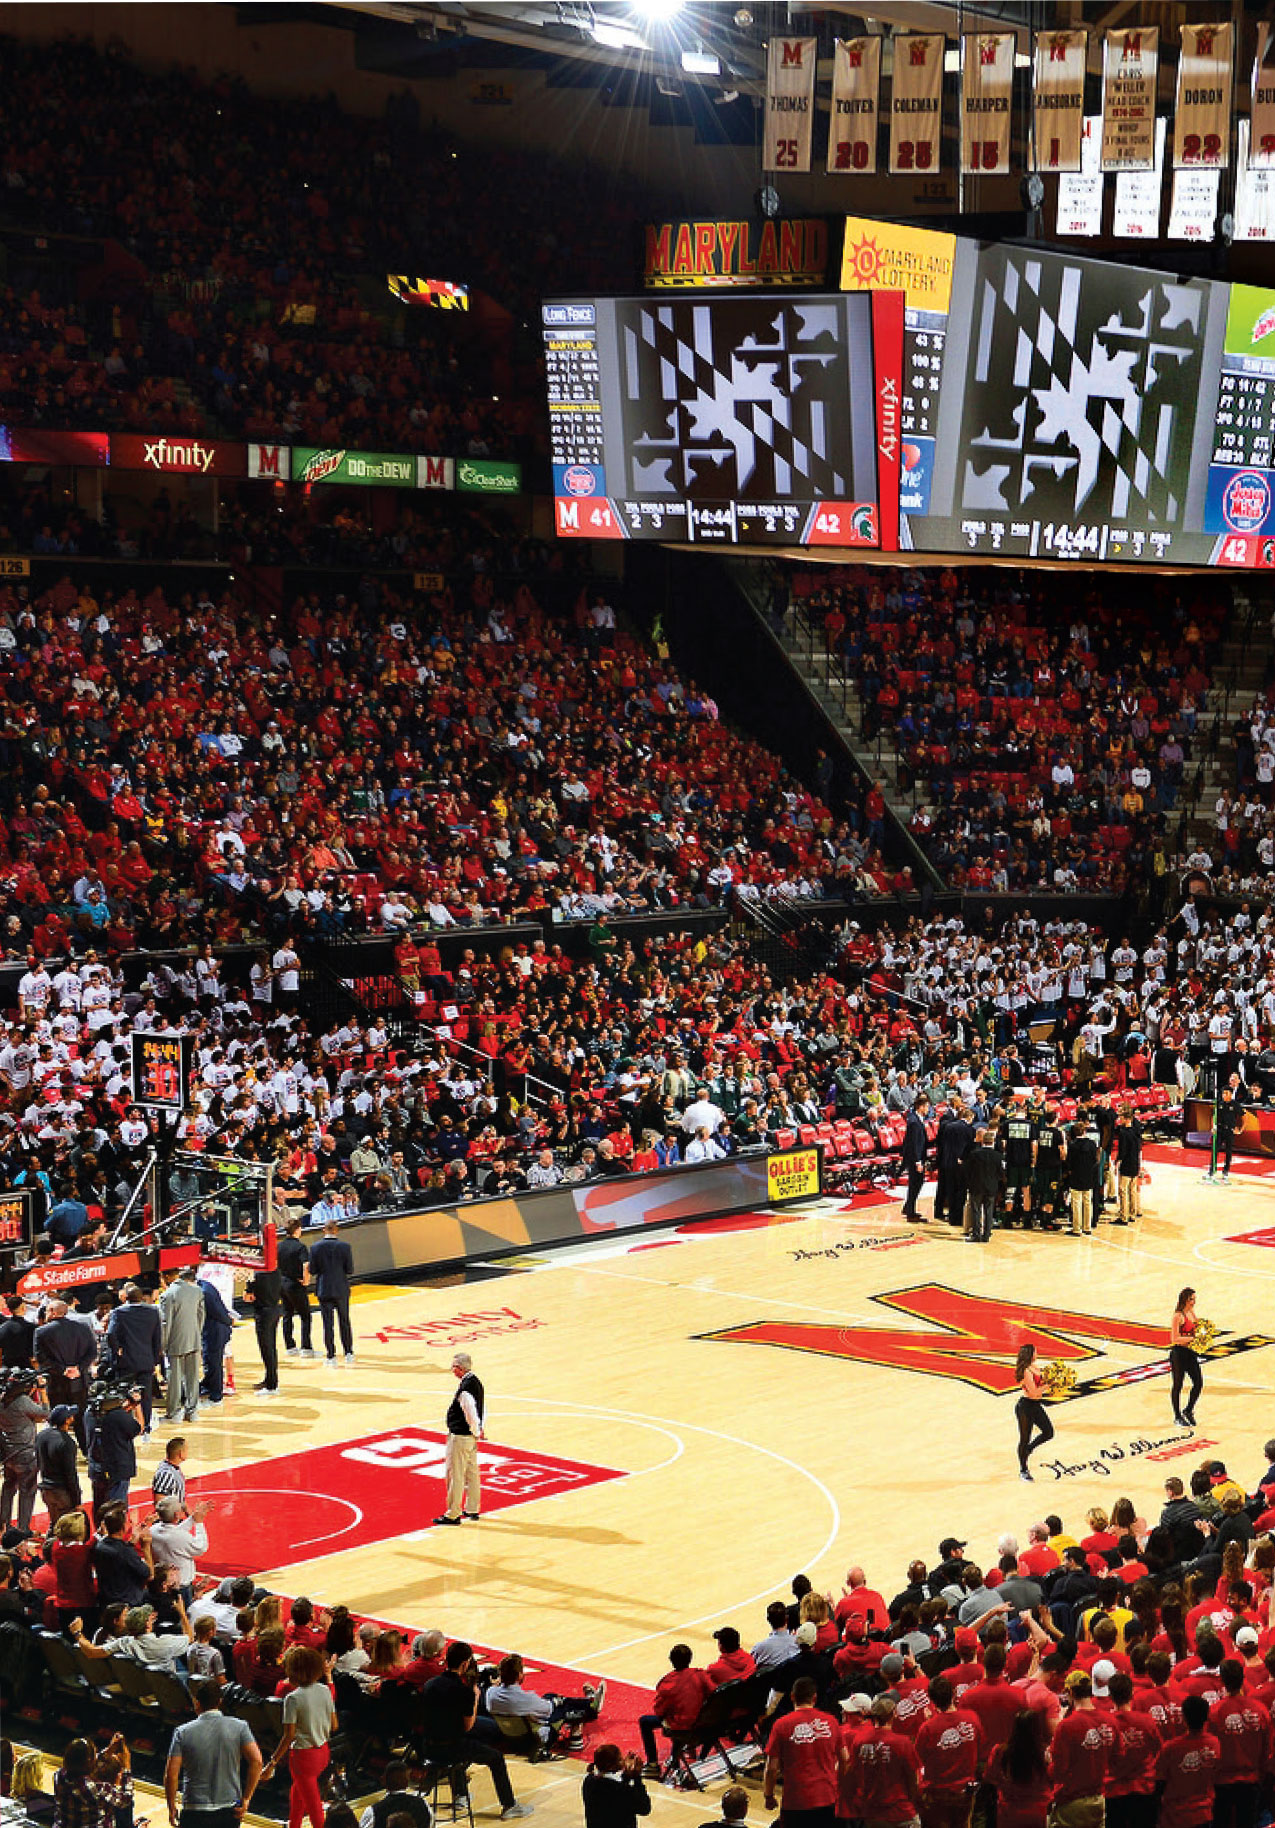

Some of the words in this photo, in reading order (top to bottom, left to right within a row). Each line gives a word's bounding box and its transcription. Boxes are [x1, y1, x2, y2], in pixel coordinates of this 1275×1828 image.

[771, 96, 808, 112] THOMAS
[894, 98, 939, 113] COLEMAN
[966, 97, 1009, 113] HARPER
[1185, 88, 1223, 106] DORON
[776, 140, 798, 167] 25
[835, 141, 869, 169] 20
[897, 141, 933, 169] 25
[970, 142, 999, 170] 15
[1049, 137, 1060, 167] 1
[1182, 133, 1221, 165] 22
[645, 222, 829, 274] MARYLAND
[885, 249, 950, 274] MARYLAND
[883, 269, 937, 292] LOTTERY
[879, 376, 899, 461] xfinity
[144, 438, 215, 473] xfinity
[258, 445, 280, 476] M
[426, 457, 446, 486] M
[559, 501, 579, 529] M
[589, 510, 612, 527] 41
[632, 515, 642, 528] 2
[652, 515, 662, 528] 3
[692, 508, 732, 525] 14:44
[765, 517, 777, 532] 2
[816, 513, 841, 533] 42
[1043, 522, 1099, 553] 14:44
[1224, 539, 1247, 563] 42
[145, 1063, 177, 1099] 30
[769, 1153, 816, 1179] OLLIE'S
[358, 1307, 522, 1344] xfinity
